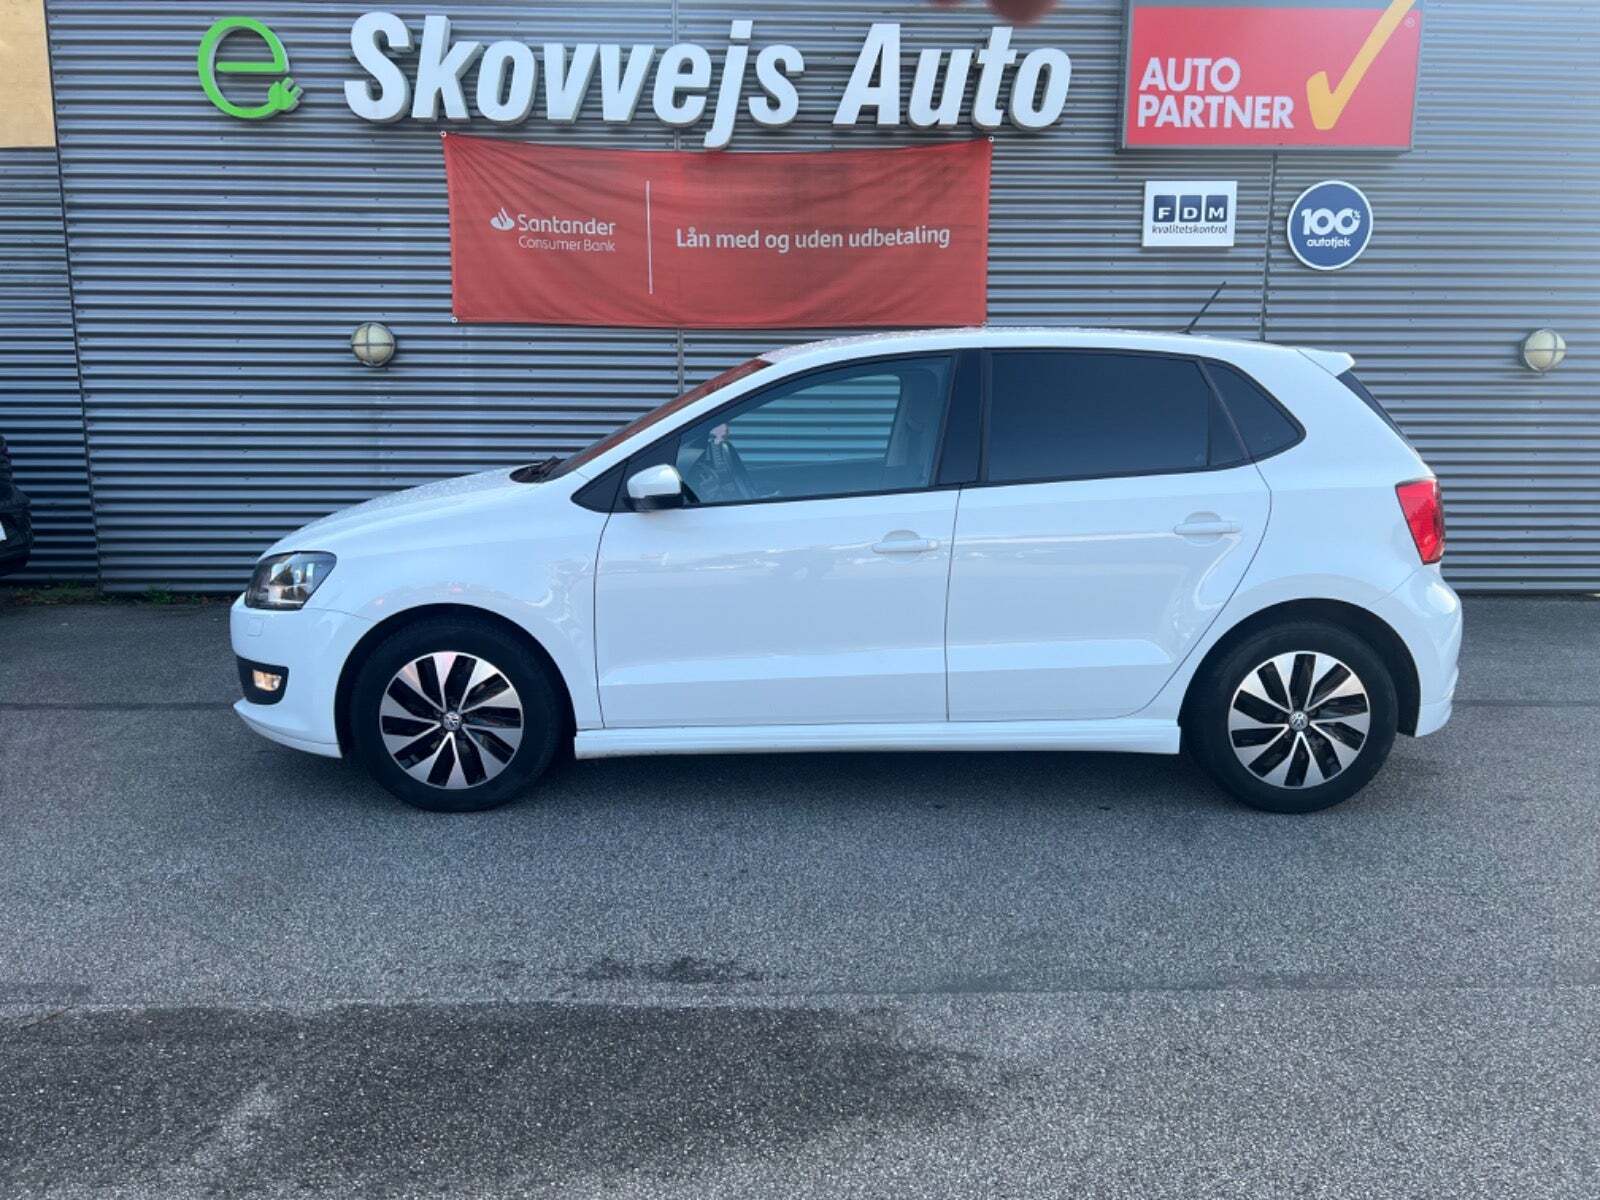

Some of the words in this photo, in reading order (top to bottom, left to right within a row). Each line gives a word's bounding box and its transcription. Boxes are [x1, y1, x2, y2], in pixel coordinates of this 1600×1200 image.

[344, 12, 806, 148] Skovvejs
[832, 23, 1073, 131] Auto
[1138, 57, 1241, 92] AUTO
[1137, 95, 1295, 129] PARTNER
[517, 213, 616, 236] Santander
[1151, 224, 1228, 235] kvalitetskontrol
[518, 235, 581, 251] Consumer
[583, 239, 616, 252] Bank
[675, 226, 711, 248] Lån
[716, 229, 760, 249] med
[764, 234, 790, 254] og
[794, 229, 843, 249] uden
[848, 225, 951, 249] udbetaling
[1306, 236, 1351, 249] autotjek
